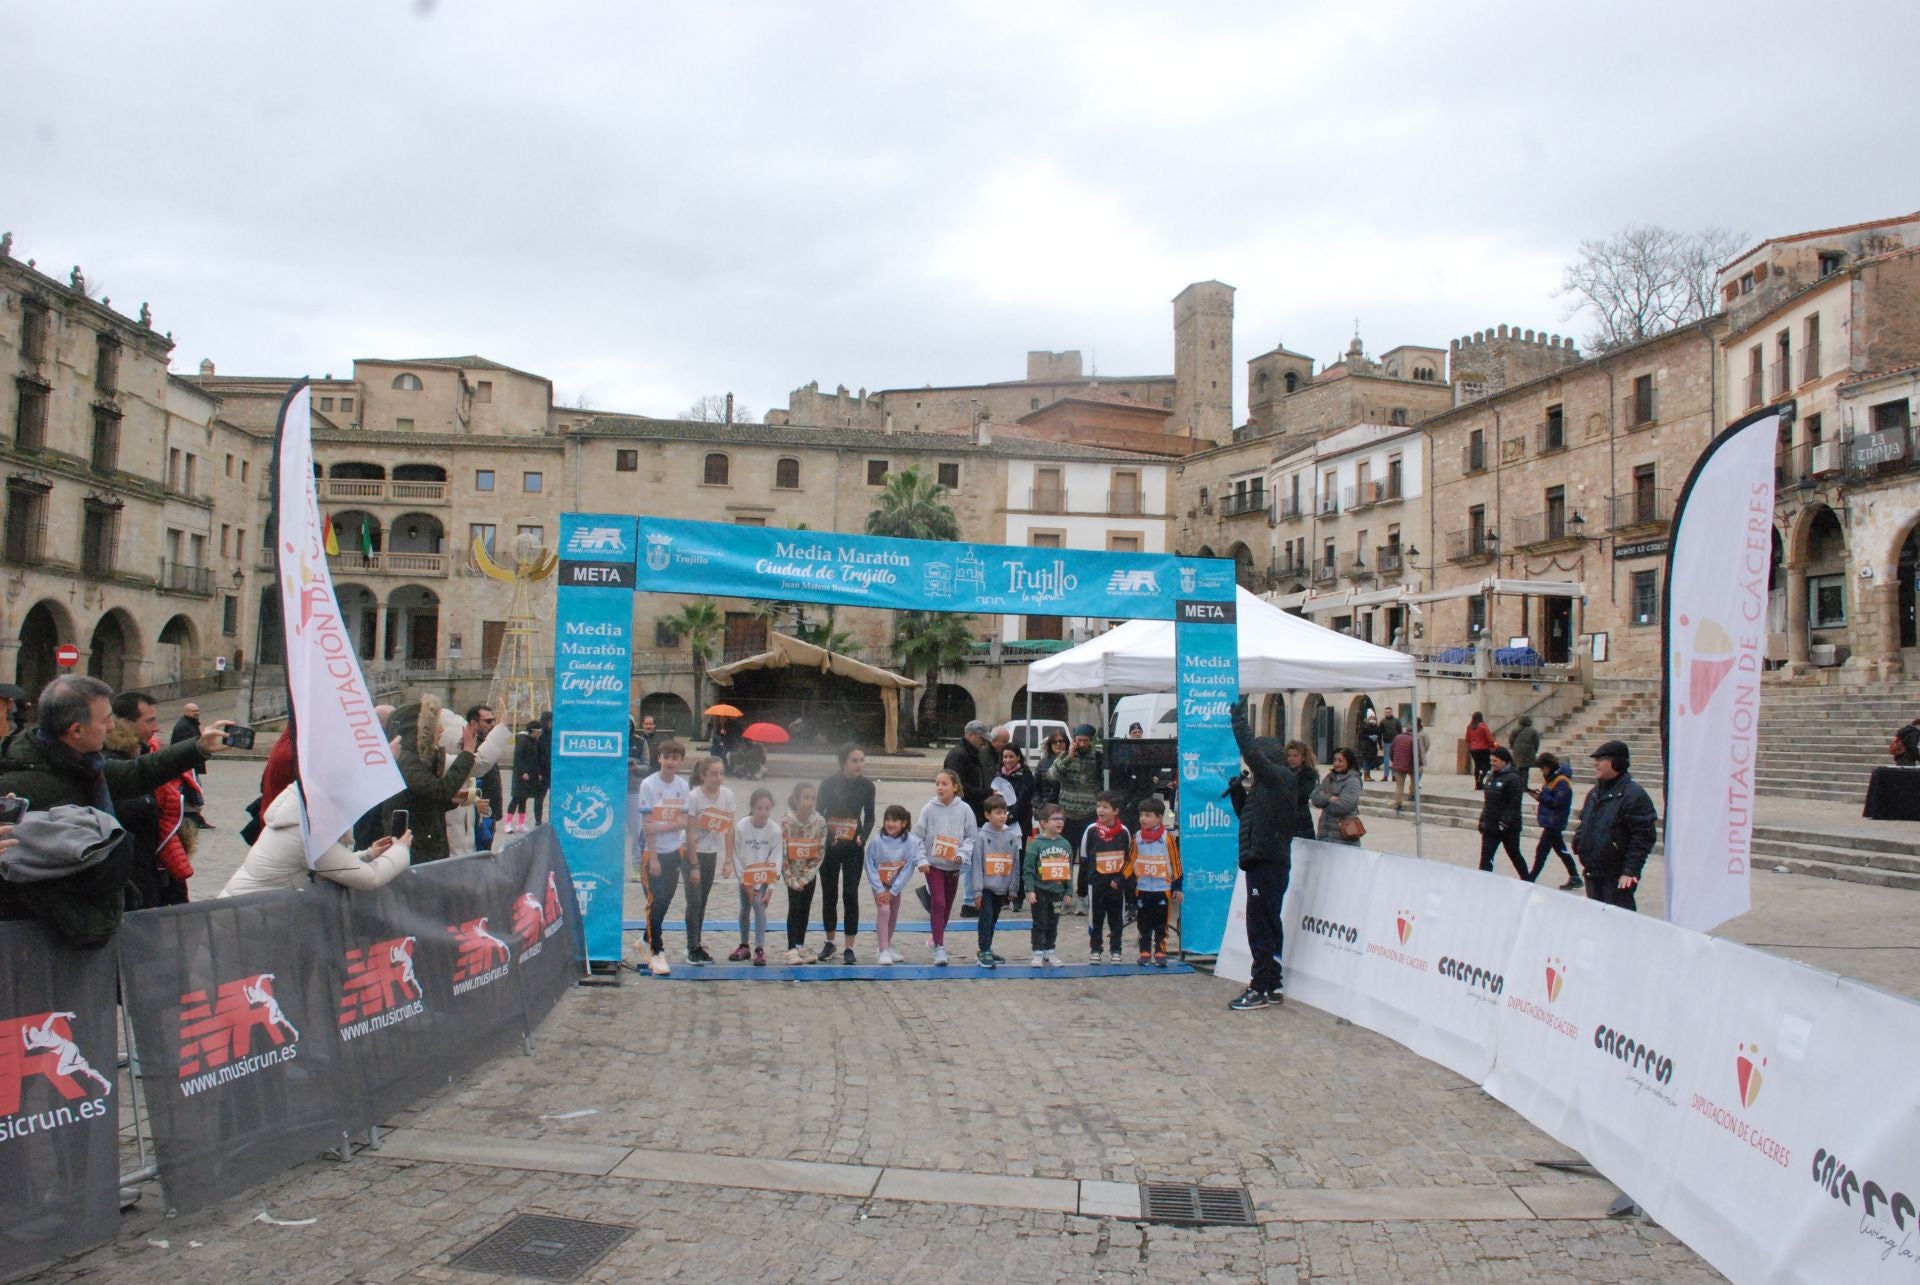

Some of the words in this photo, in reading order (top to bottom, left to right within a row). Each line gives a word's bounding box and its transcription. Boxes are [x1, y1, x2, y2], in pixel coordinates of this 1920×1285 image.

[775, 542, 832, 561] Media
[837, 546, 910, 567] Maratón
[1740, 483, 1769, 622] CÁCERES
[573, 567, 621, 583] META
[755, 558, 813, 578] Ciudad
[816, 565, 835, 580] de
[840, 564, 897, 588] Trujillo
[1002, 560, 1078, 596] Trujillo
[312, 572, 330, 604] DE
[1185, 604, 1224, 618] META
[566, 622, 622, 636] Media
[561, 642, 626, 656] Maratón
[1738, 636, 1758, 673] DE
[569, 659, 603, 670] Ciudad
[1184, 656, 1231, 668] Media
[560, 671, 624, 697] Trujillo
[1183, 673, 1236, 685] Maratón
[314, 613, 388, 766] DIPUTACIÓN
[568, 738, 613, 750] HABLA
[1728, 684, 1755, 876] DIPUTACIÓN
[796, 847, 810, 858] 63
[1051, 867, 1064, 878] 52
[1105, 860, 1117, 871] 51
[1144, 865, 1157, 875] 50
[753, 871, 768, 883] 60
[340, 1000, 423, 1041] www.musicrun.es
[180, 1044, 297, 1097] www.musicrun.es
[1737, 1120, 1750, 1142] DE
[1750, 1129, 1791, 1168] CÁCERES
